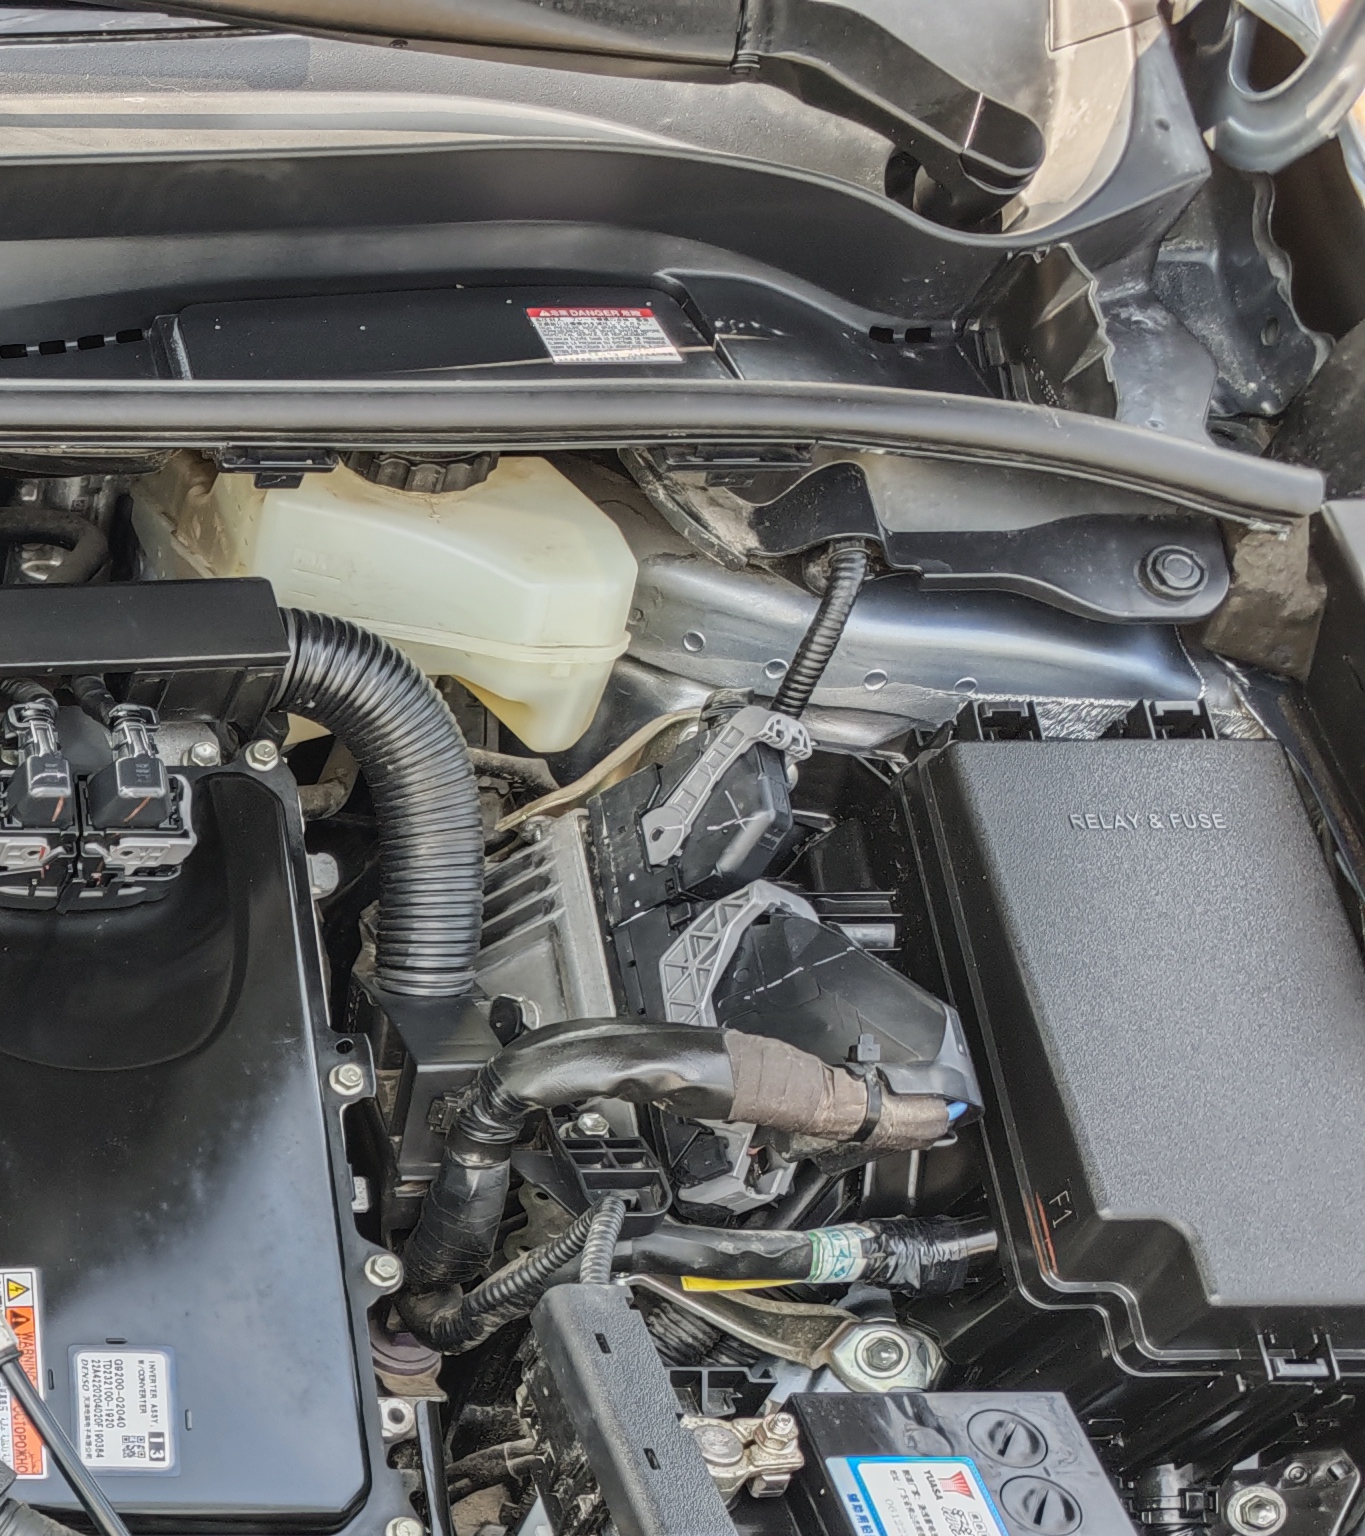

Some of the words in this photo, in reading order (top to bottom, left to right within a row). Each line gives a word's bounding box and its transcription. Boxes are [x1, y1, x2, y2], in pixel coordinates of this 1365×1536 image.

[570, 309, 620, 317] DANGER
[1069, 813, 1139, 829] RELAY
[1148, 813, 1165, 829] &
[1169, 813, 1227, 829] FUSE
[1048, 1190, 1073, 1229] F1
[81, 1358, 90, 1392] DENSO
[137, 1359, 147, 1415] W/CONVERTER
[148, 1360, 157, 1399] INVERTER
[923, 1469, 944, 1501] YUASA
